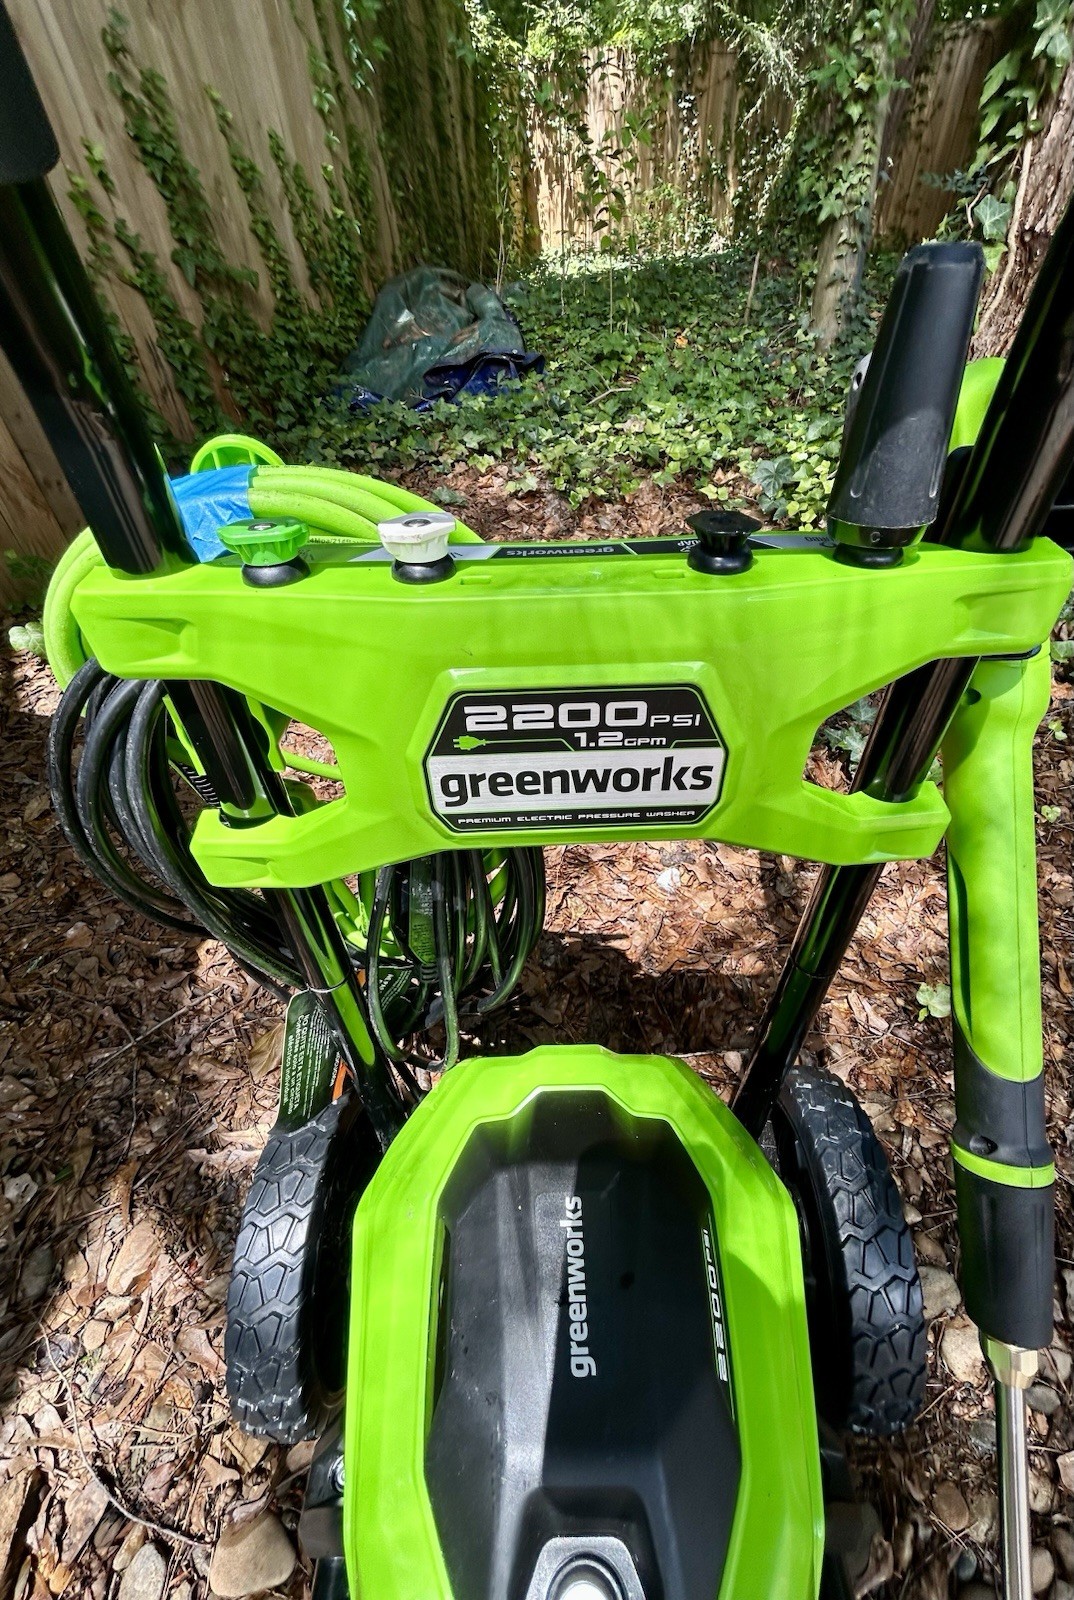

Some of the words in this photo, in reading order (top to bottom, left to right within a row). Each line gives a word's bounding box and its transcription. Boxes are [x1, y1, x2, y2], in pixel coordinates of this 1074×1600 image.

[506, 545, 615, 557] greenworks
[440, 756, 714, 807] greenworks
[458, 816, 512, 825] PREMIUM
[517, 813, 573, 822] ELECTRIC
[578, 811, 641, 820] PRESSURE
[646, 810, 696, 818] WASHER
[302, 1013, 310, 1026] NO
[300, 1027, 308, 1051] QUITE
[296, 1051, 305, 1072] ESTA
[293, 1072, 302, 1110] ETIQUETA
[560, 1196, 597, 1378] greenworks
